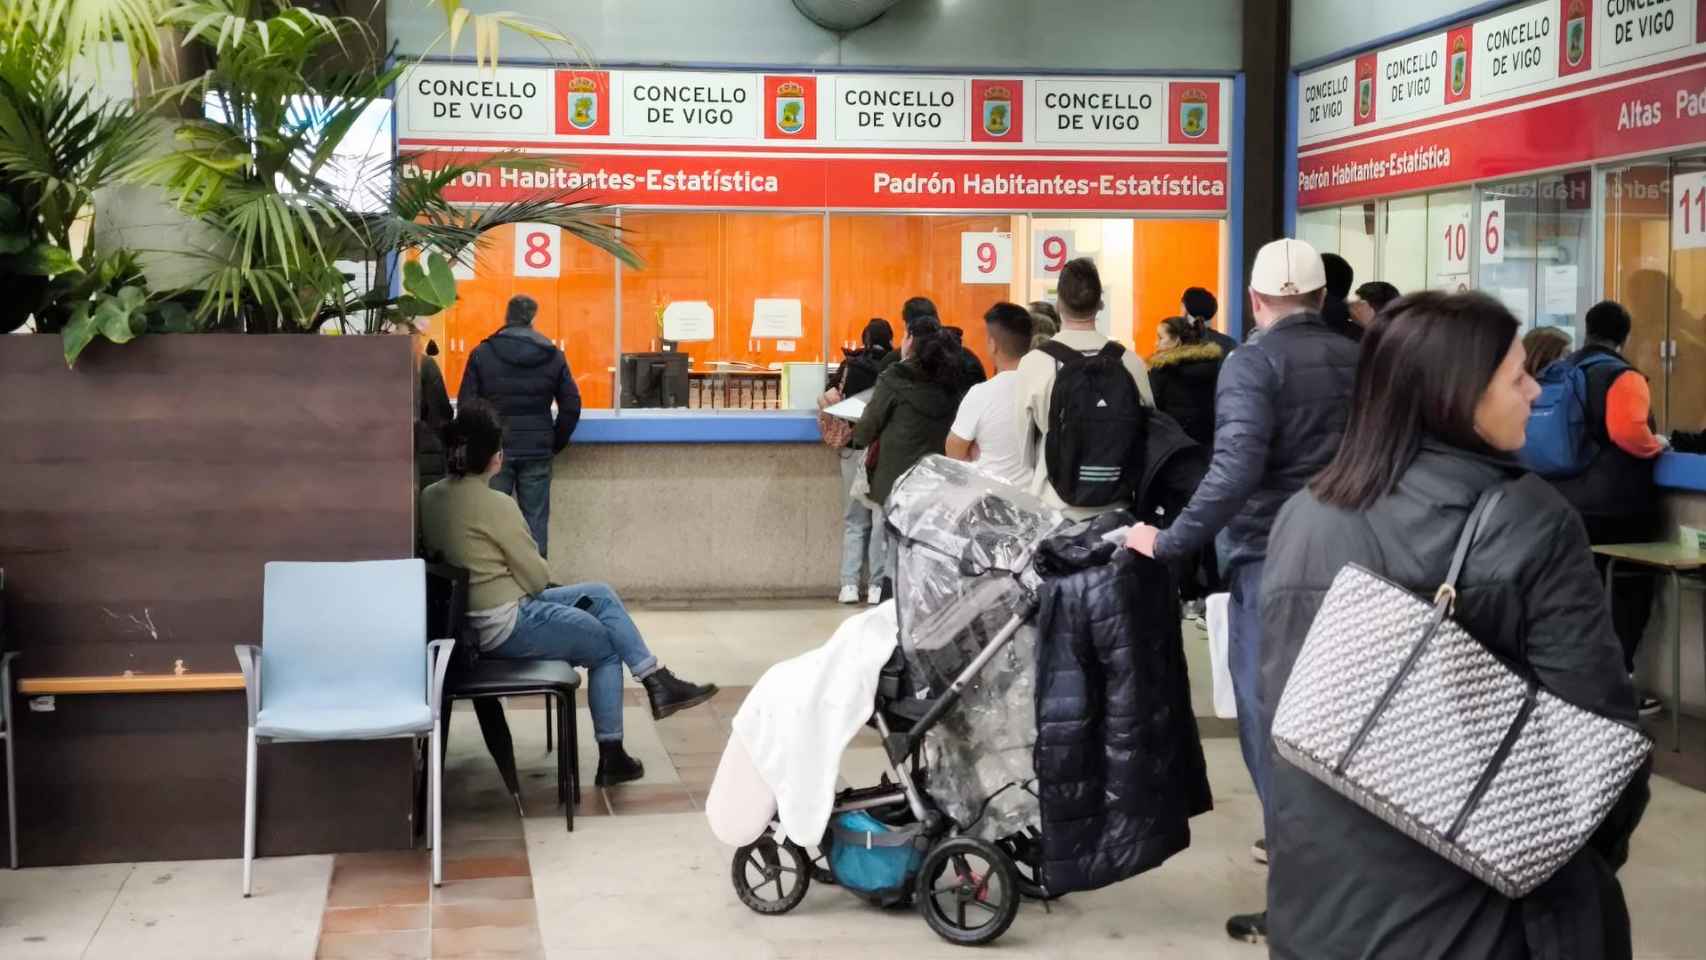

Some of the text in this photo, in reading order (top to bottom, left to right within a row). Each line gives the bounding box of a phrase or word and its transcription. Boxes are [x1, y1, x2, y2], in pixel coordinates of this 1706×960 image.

[1486, 16, 1550, 52] CONCELLO
[1615, 20, 1633, 45] DE
[1638, 9, 1674, 38] VIGO
[1386, 50, 1438, 80] CONCELLO
[1493, 46, 1541, 76] DE VIGO
[418, 79, 537, 99] CONCELLO
[633, 85, 747, 104] CONCELLO
[845, 89, 955, 108] CONCELLO
[1044, 92, 1153, 110] CONCELLO
[1305, 75, 1348, 103] CONCELLO
[1392, 76, 1430, 103] DE VIGO
[432, 101, 524, 121] DE VIGO
[647, 107, 734, 125] DE VIGO
[858, 111, 943, 129] DE VIGO
[1057, 113, 1141, 131] DE VIGO
[1310, 100, 1343, 123] DE VIGO
[1617, 99, 1661, 131] Altas
[1298, 144, 1450, 191] Padrón Habitantes-Estatística
[873, 172, 1225, 196] Padrón Habitantes-Estatística
[1680, 187, 1706, 234] 11
[1444, 223, 1466, 261] 10
[1485, 210, 1499, 254] 6
[524, 231, 551, 269] 8
[976, 242, 998, 274] 9
[1043, 236, 1068, 272] 9
